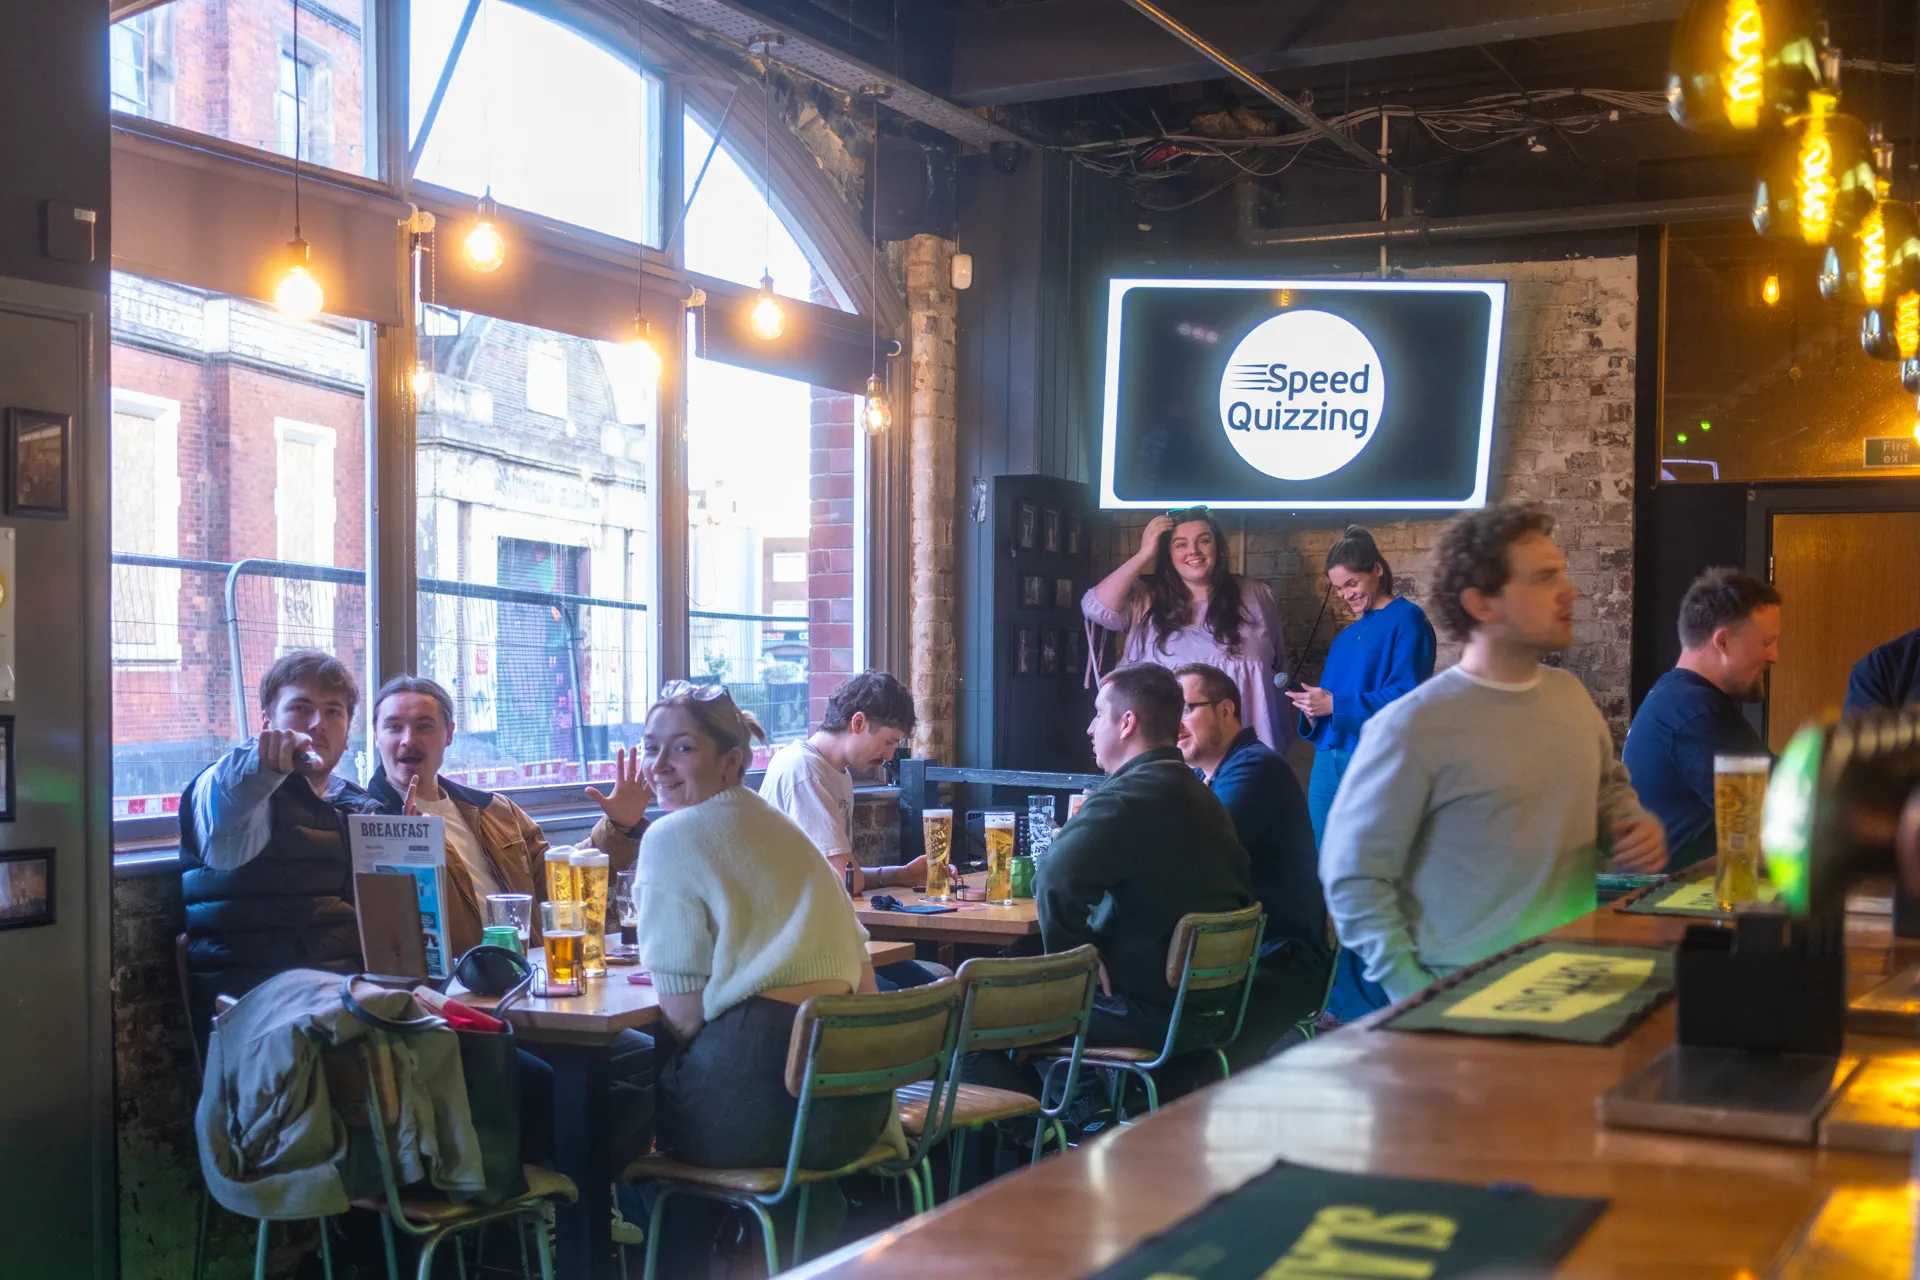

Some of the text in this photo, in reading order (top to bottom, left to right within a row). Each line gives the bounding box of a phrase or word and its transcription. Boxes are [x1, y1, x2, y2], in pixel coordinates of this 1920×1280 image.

[1267, 363, 1370, 401] Speed
[1228, 401, 1369, 439] Quizzing
[1883, 441, 1910, 451] Fire
[1883, 453, 1909, 463] exit
[361, 822, 430, 838] BREAKFAST
